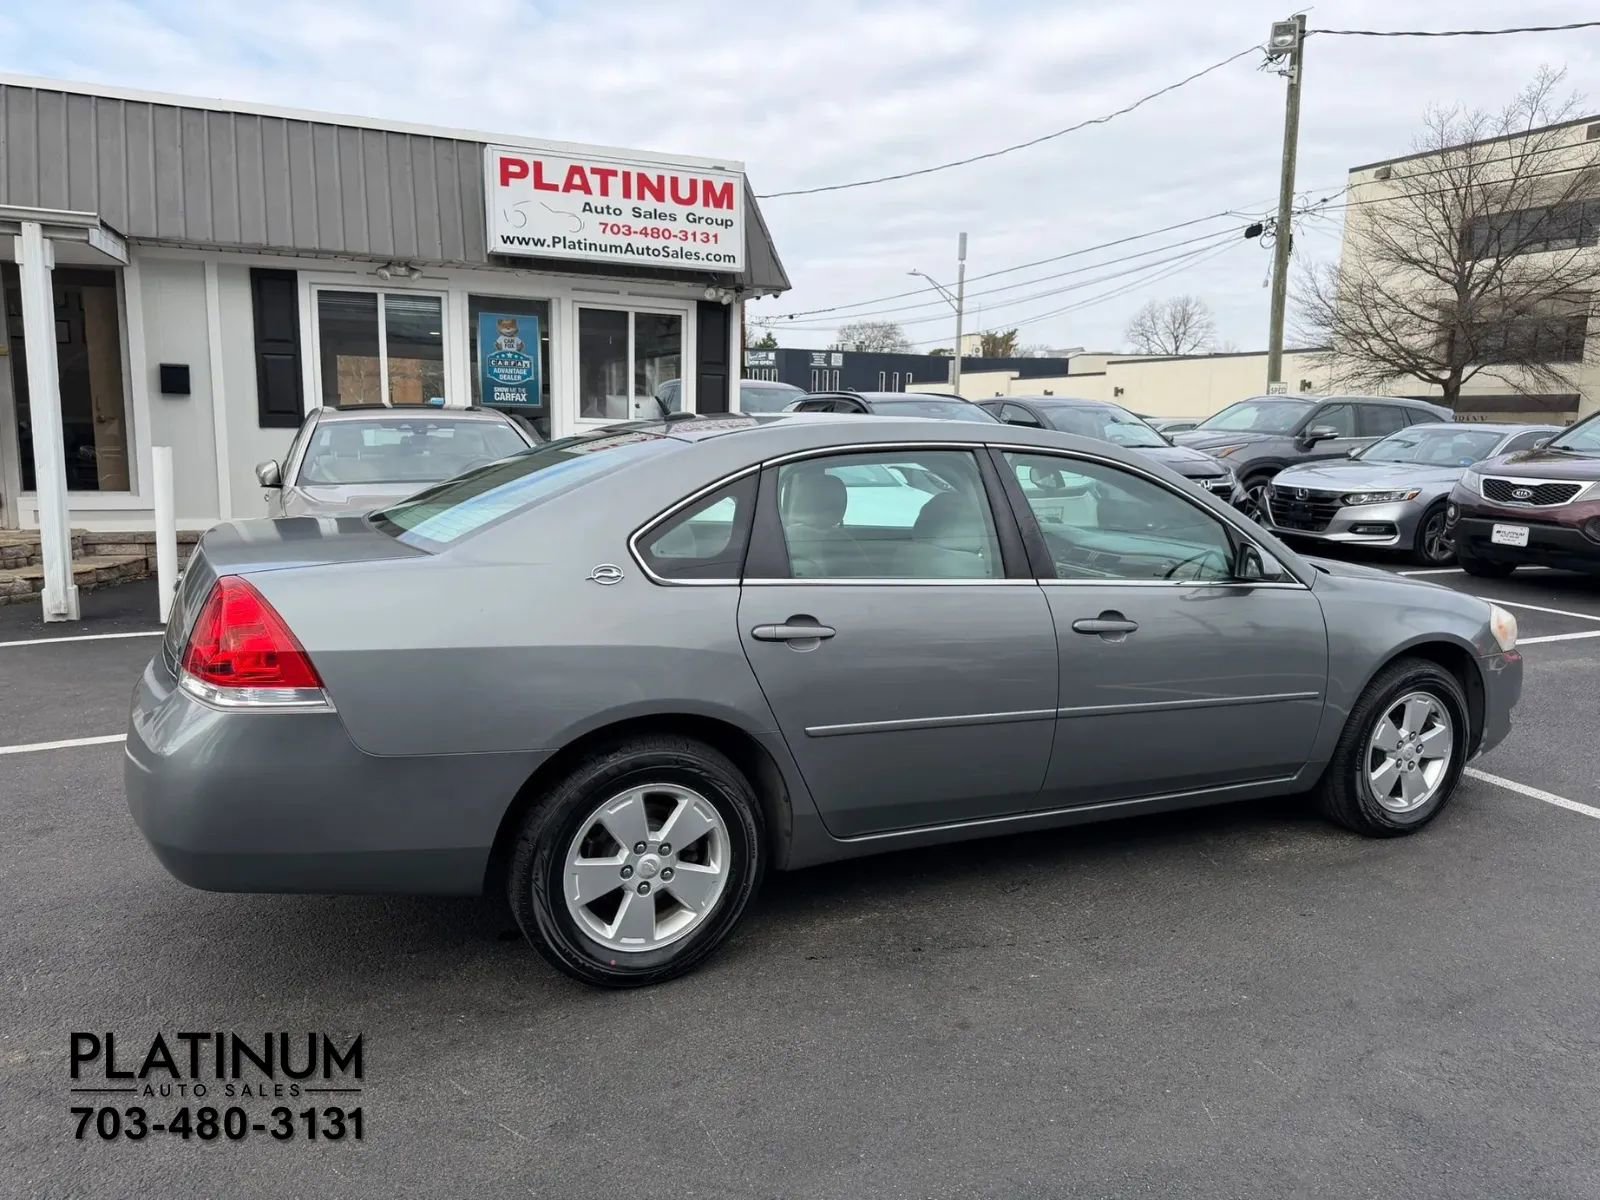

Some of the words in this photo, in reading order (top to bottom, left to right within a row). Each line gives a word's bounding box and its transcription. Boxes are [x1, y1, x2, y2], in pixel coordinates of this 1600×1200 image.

[500, 156, 734, 210] PLATINUM
[582, 201, 623, 217] Auto
[632, 207, 677, 222] Sales
[686, 212, 734, 229] Group
[598, 222, 719, 244] 703-480-3131
[500, 234, 736, 264] www.PlatinumAutoSales.com
[491, 360, 530, 368] CARFAX
[493, 367, 527, 375] ADVANTAGE
[494, 392, 527, 401] CARFAX
